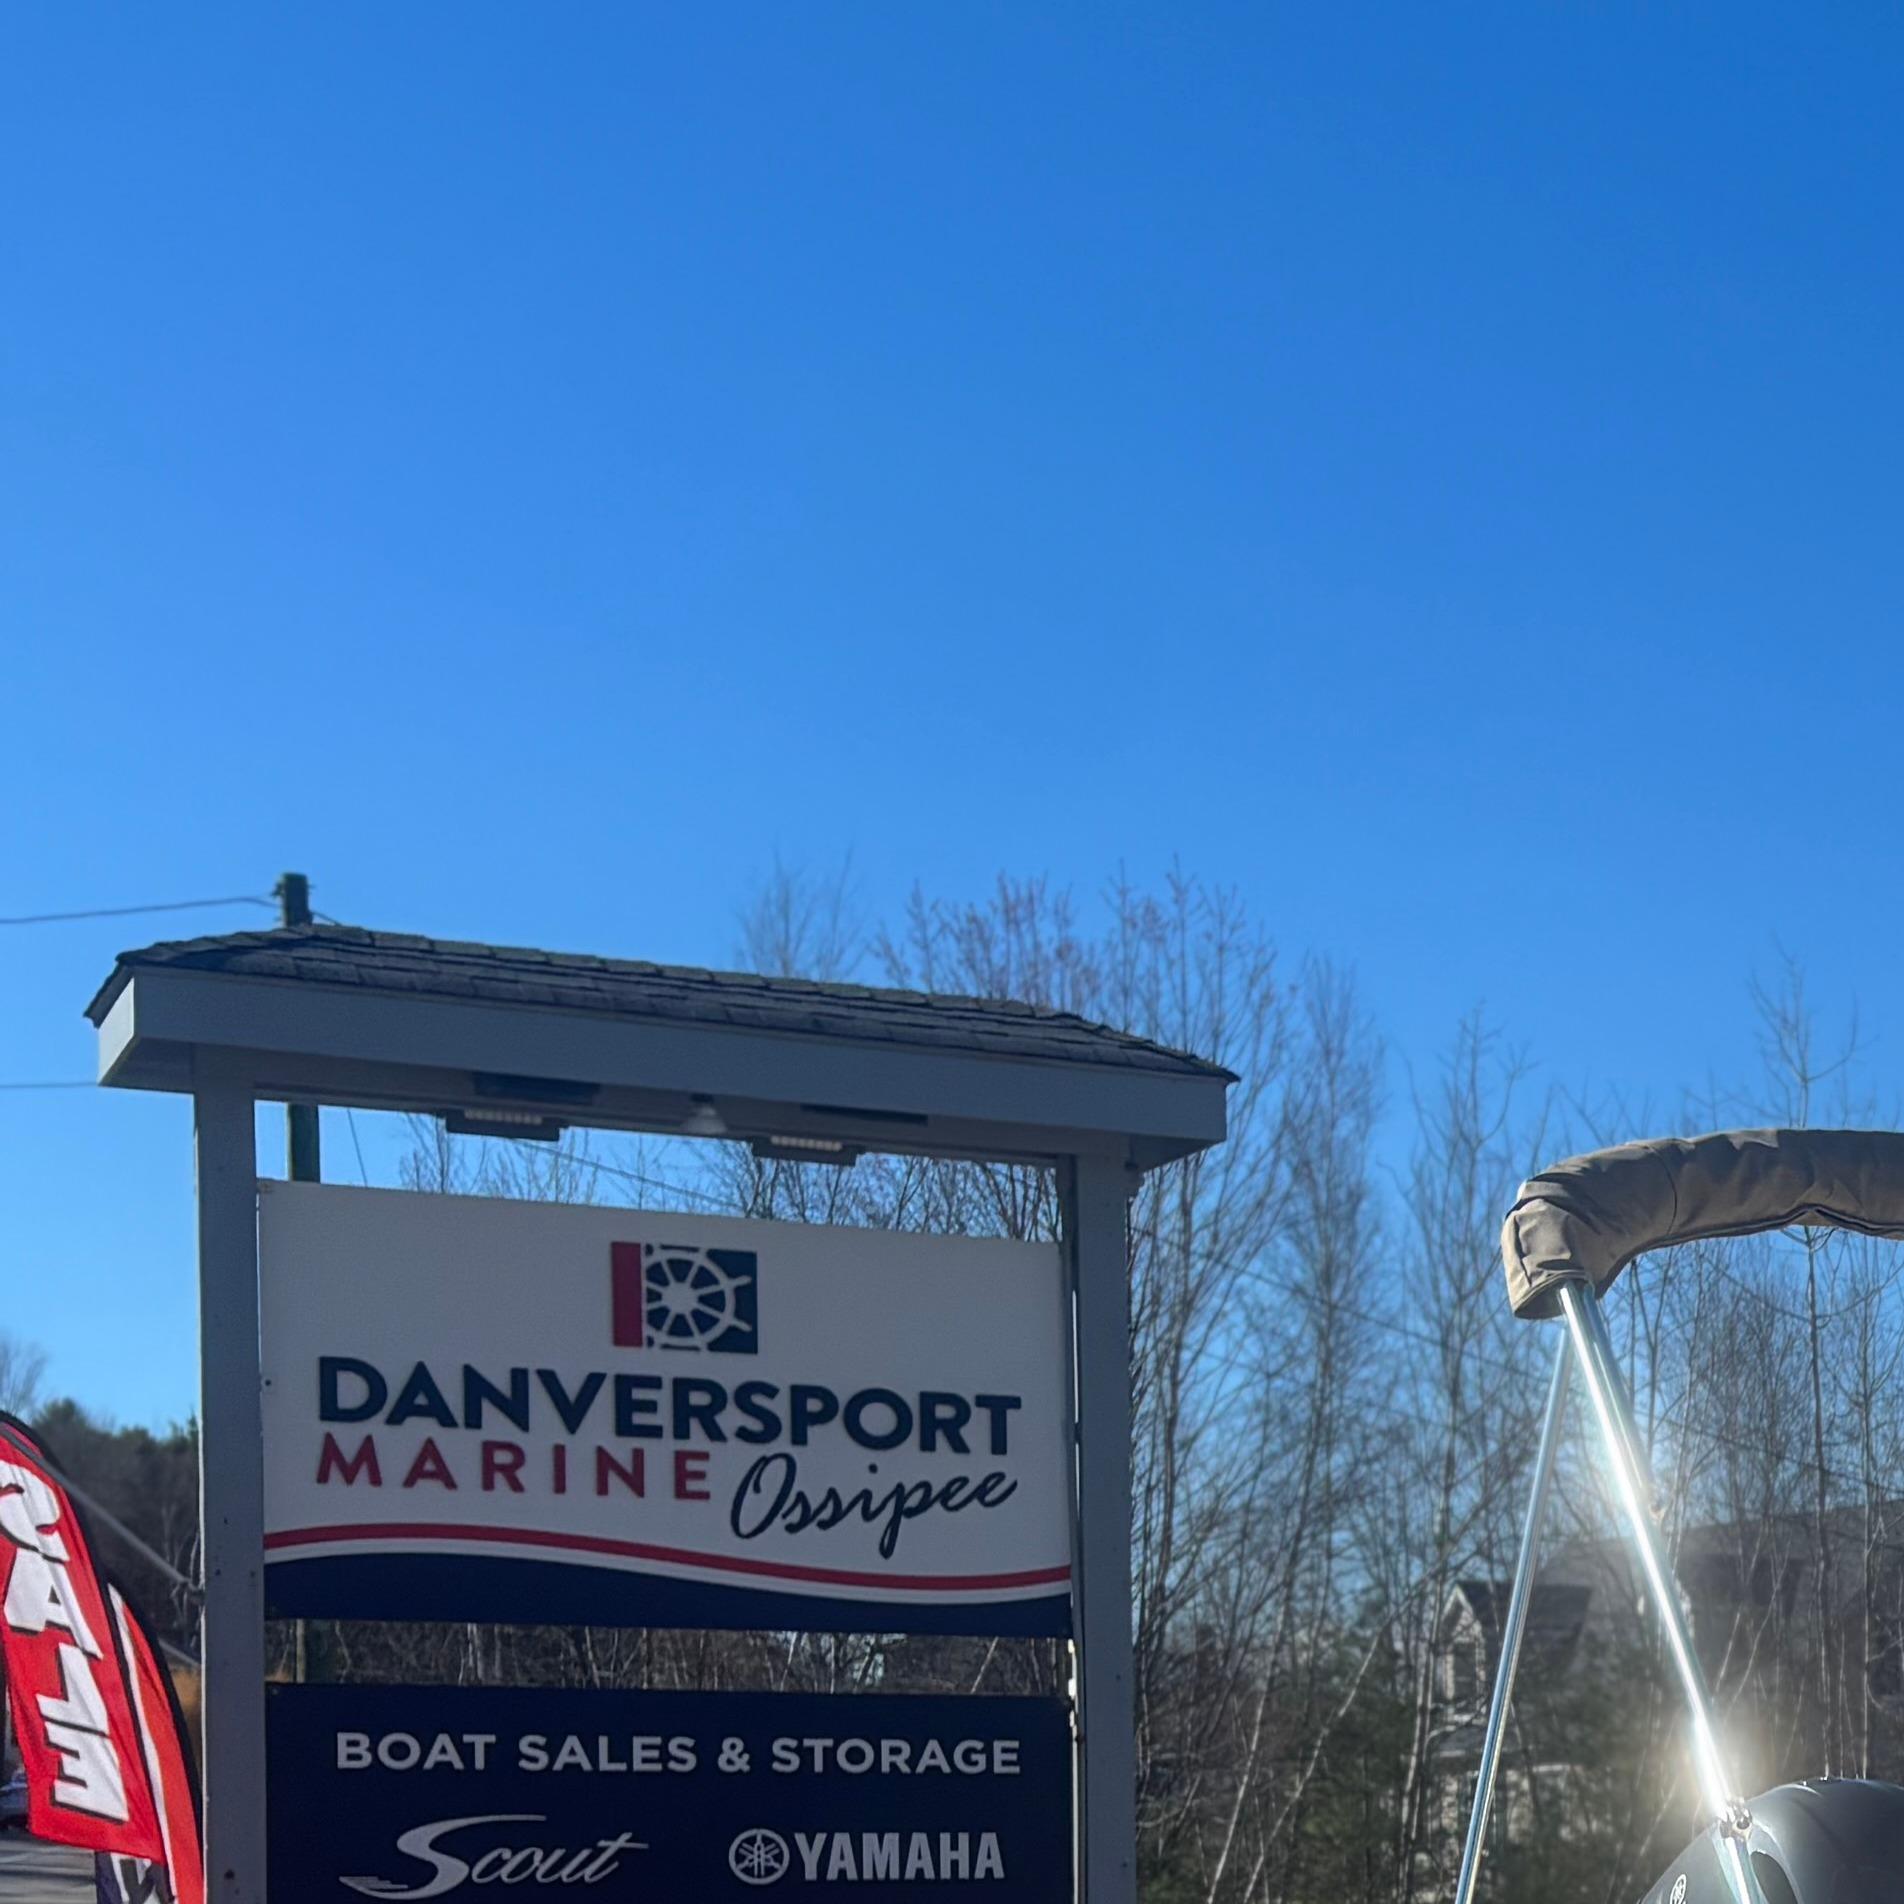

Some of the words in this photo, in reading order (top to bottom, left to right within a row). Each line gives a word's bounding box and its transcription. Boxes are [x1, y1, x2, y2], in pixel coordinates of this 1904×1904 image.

[318, 1356, 1022, 1456] DANVERSPORT
[316, 1432, 712, 1501] MARINE
[730, 1452, 1018, 1561] Ossipee
[337, 1732, 497, 1771] BOAT
[518, 1734, 698, 1773] SALES
[717, 1736, 752, 1774] &
[771, 1737, 1022, 1775] STORAGE
[338, 1814, 650, 1901] Scout
[795, 1831, 1006, 1881] YAMAHA
